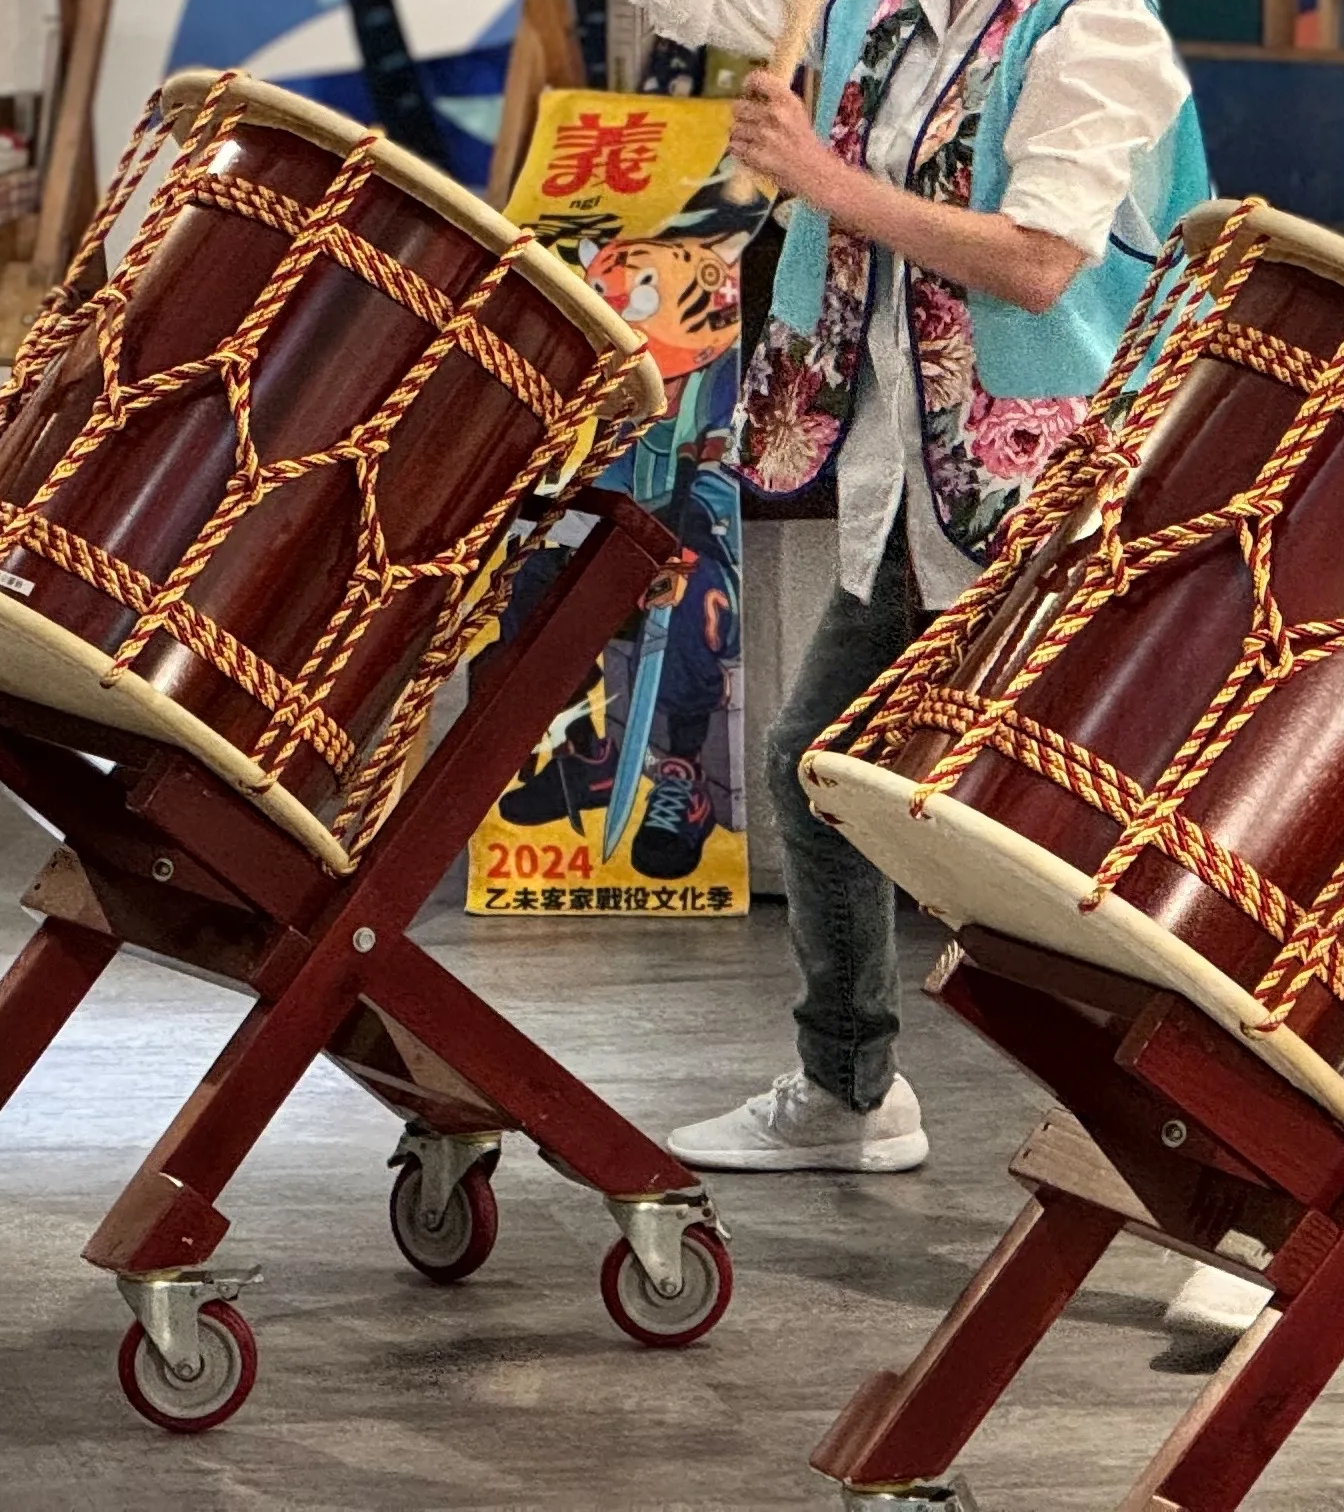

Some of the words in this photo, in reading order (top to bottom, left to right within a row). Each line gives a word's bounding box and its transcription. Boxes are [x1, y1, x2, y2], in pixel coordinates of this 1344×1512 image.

[542, 112, 667, 197] 義
[486, 843, 593, 879] 2024
[485, 886, 733, 911] 乙未客家戰役文化季
